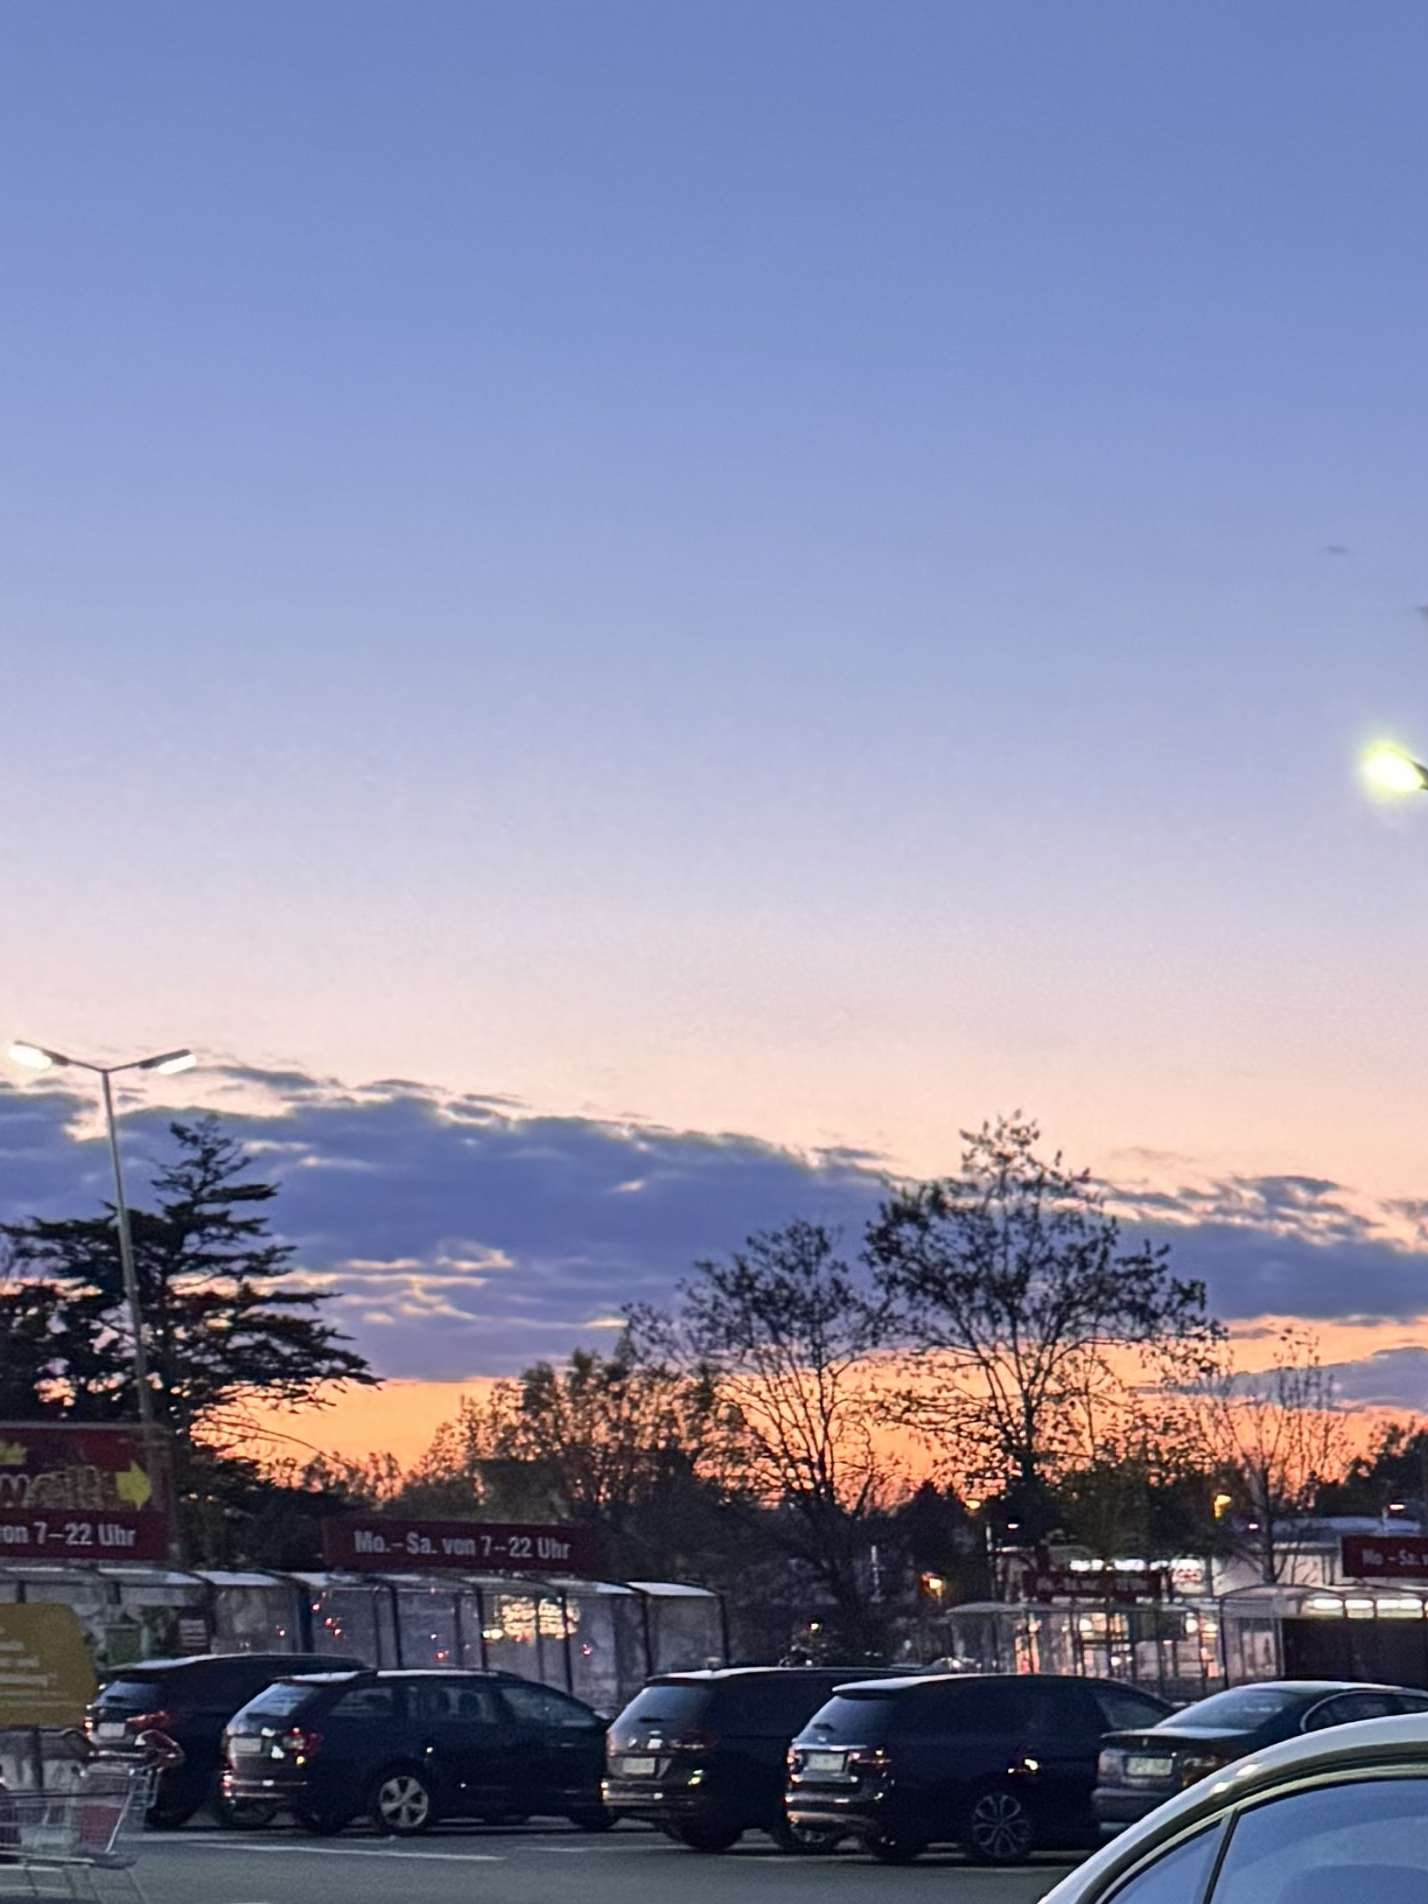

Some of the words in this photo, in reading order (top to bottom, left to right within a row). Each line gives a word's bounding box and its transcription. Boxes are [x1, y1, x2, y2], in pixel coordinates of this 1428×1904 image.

[0, 1525, 29, 1544] on
[98, 1524, 136, 1546] Uhr
[442, 1537, 476, 1555] von
[537, 1538, 571, 1560] Uhr
